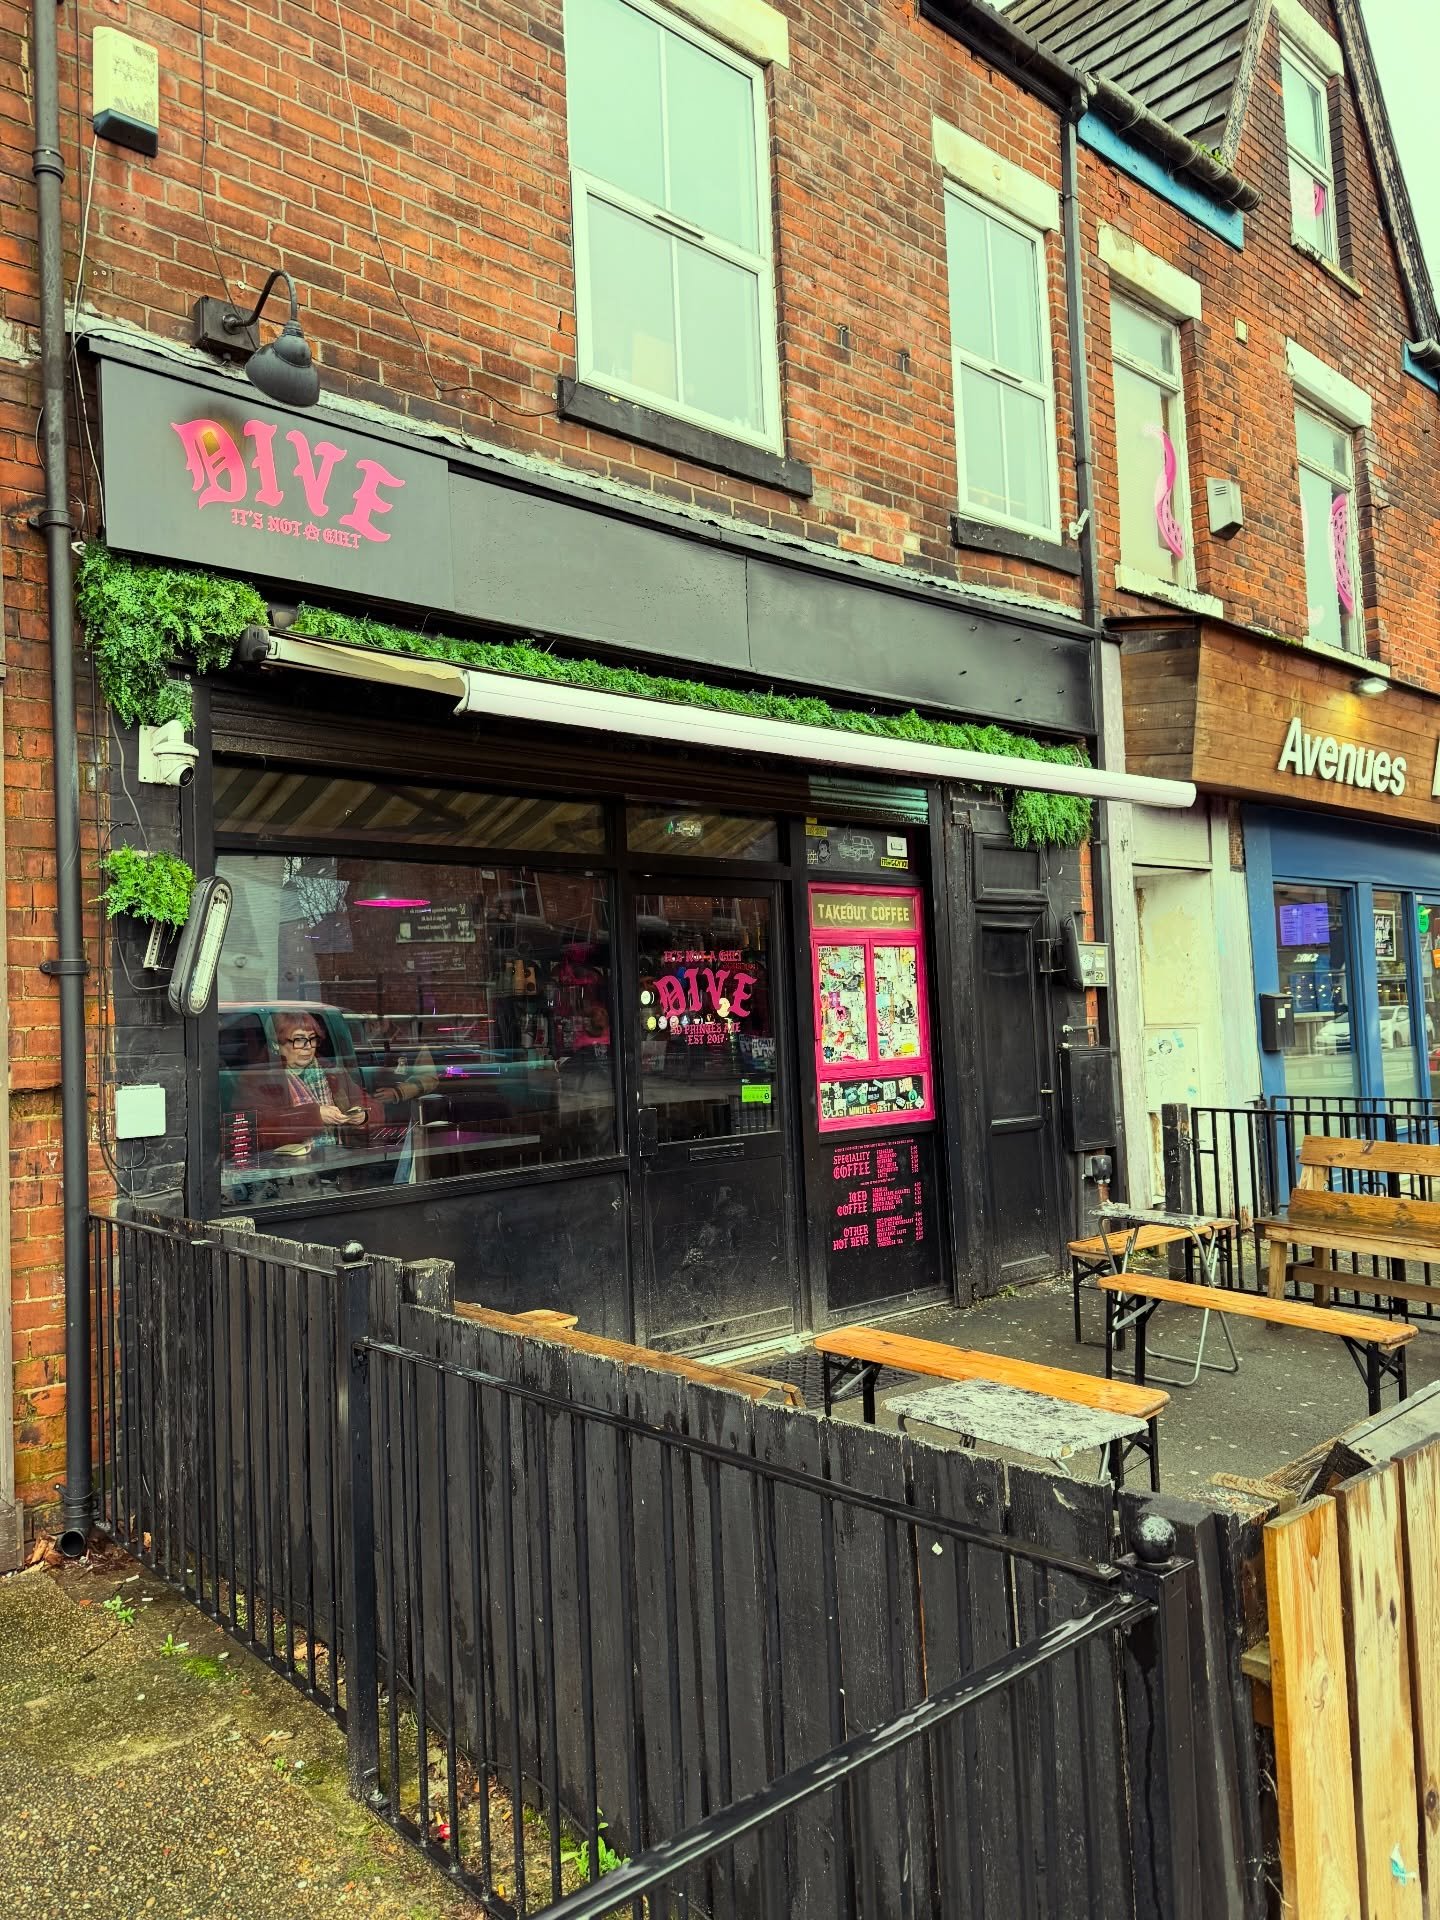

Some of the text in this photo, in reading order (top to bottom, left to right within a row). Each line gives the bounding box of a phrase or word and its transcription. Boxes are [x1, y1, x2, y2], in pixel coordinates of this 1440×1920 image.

[170, 418, 406, 543] DIVE
[231, 508, 263, 530] IT'S
[267, 515, 303, 537] NOT
[322, 527, 361, 550] CULT
[1277, 717, 1407, 796] Avenues
[817, 903, 910, 922] TAKEOUT COFFEE
[653, 967, 757, 1019] DIVE
[848, 1105, 871, 1116] MINUTE
[832, 1151, 871, 1165] SPECIALITY
[833, 1161, 871, 1179] COFFEE
[848, 1190, 868, 1203] ICED
[836, 1201, 868, 1216] COFFEE
[843, 1224, 869, 1238] OTHER
[833, 1238, 849, 1251] HOT
